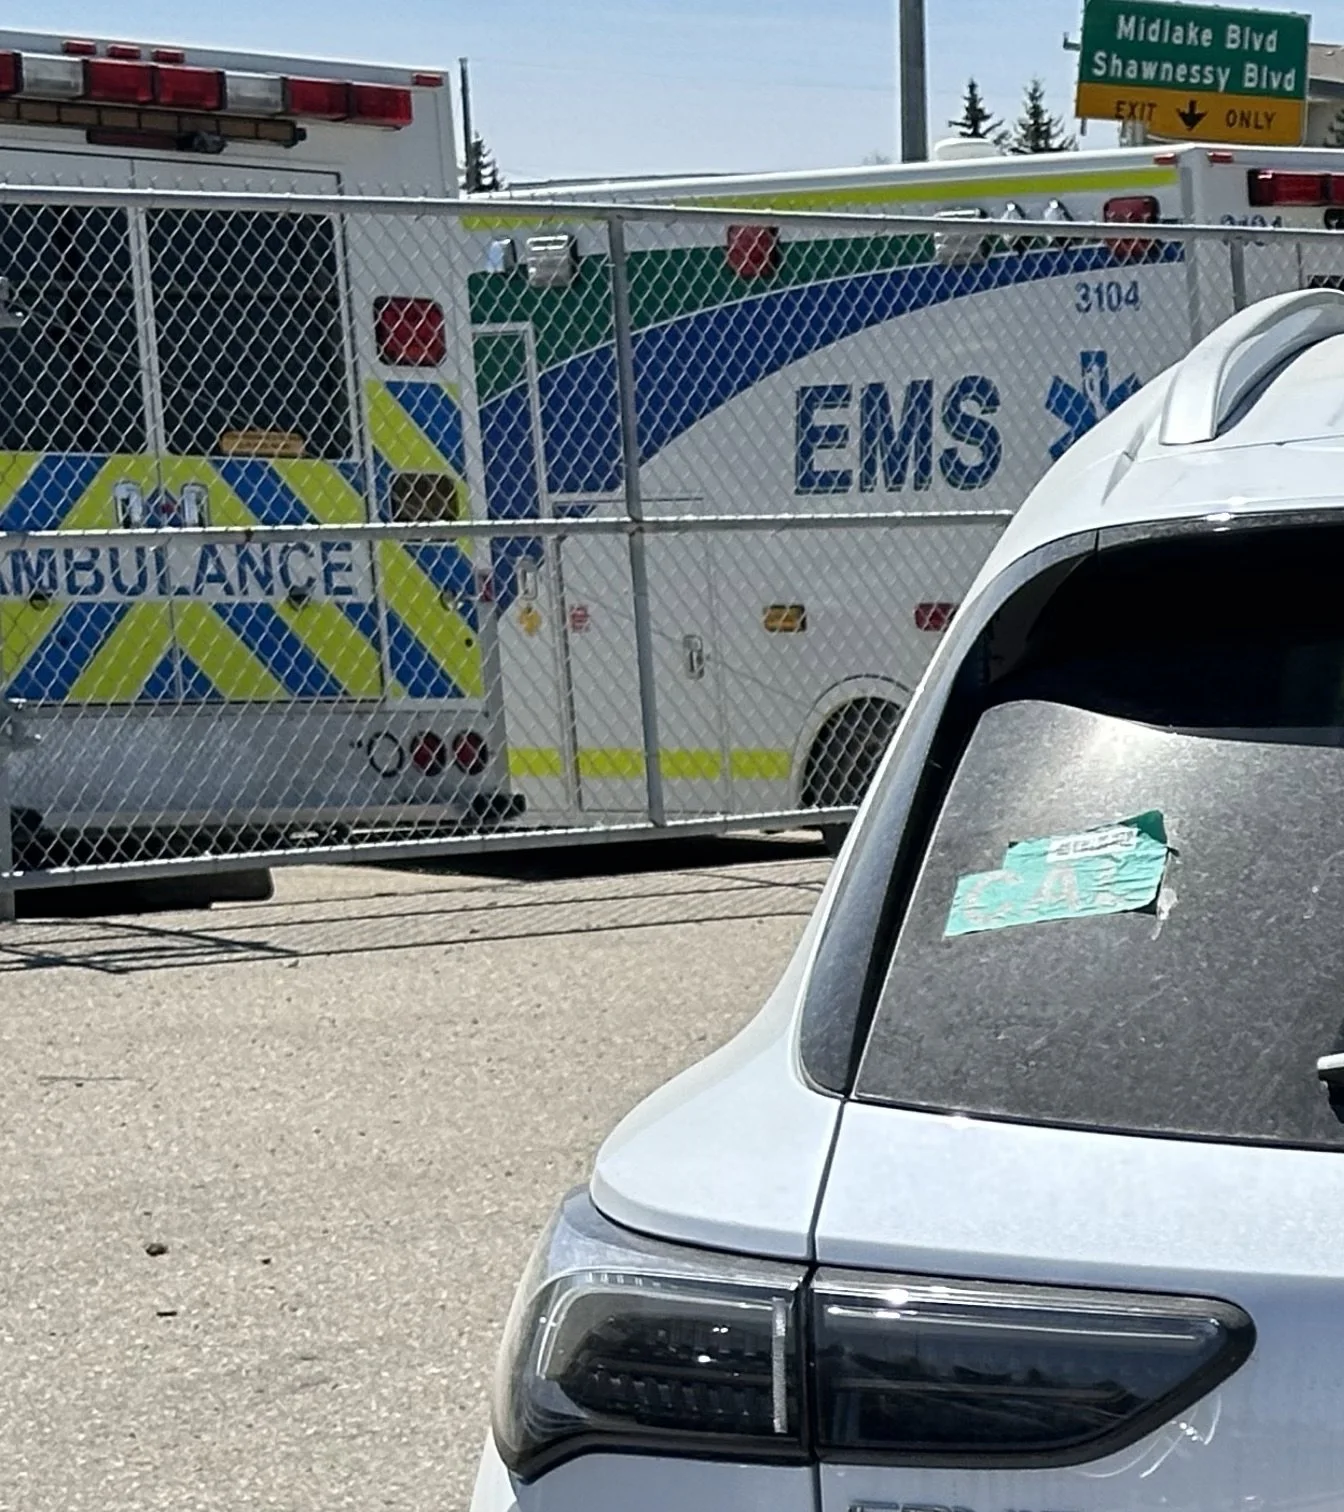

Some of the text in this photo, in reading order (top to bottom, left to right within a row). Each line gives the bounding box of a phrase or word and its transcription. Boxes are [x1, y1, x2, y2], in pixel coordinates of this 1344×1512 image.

[1116, 14, 1279, 53] Midlake Blvd
[1091, 51, 1296, 93] Shawnessy Blvd
[1114, 99, 1277, 130] EXIT ONLY
[1074, 280, 1141, 314] 3104
[795, 375, 1001, 496] EMS
[0, 540, 354, 597] MBULANCE
